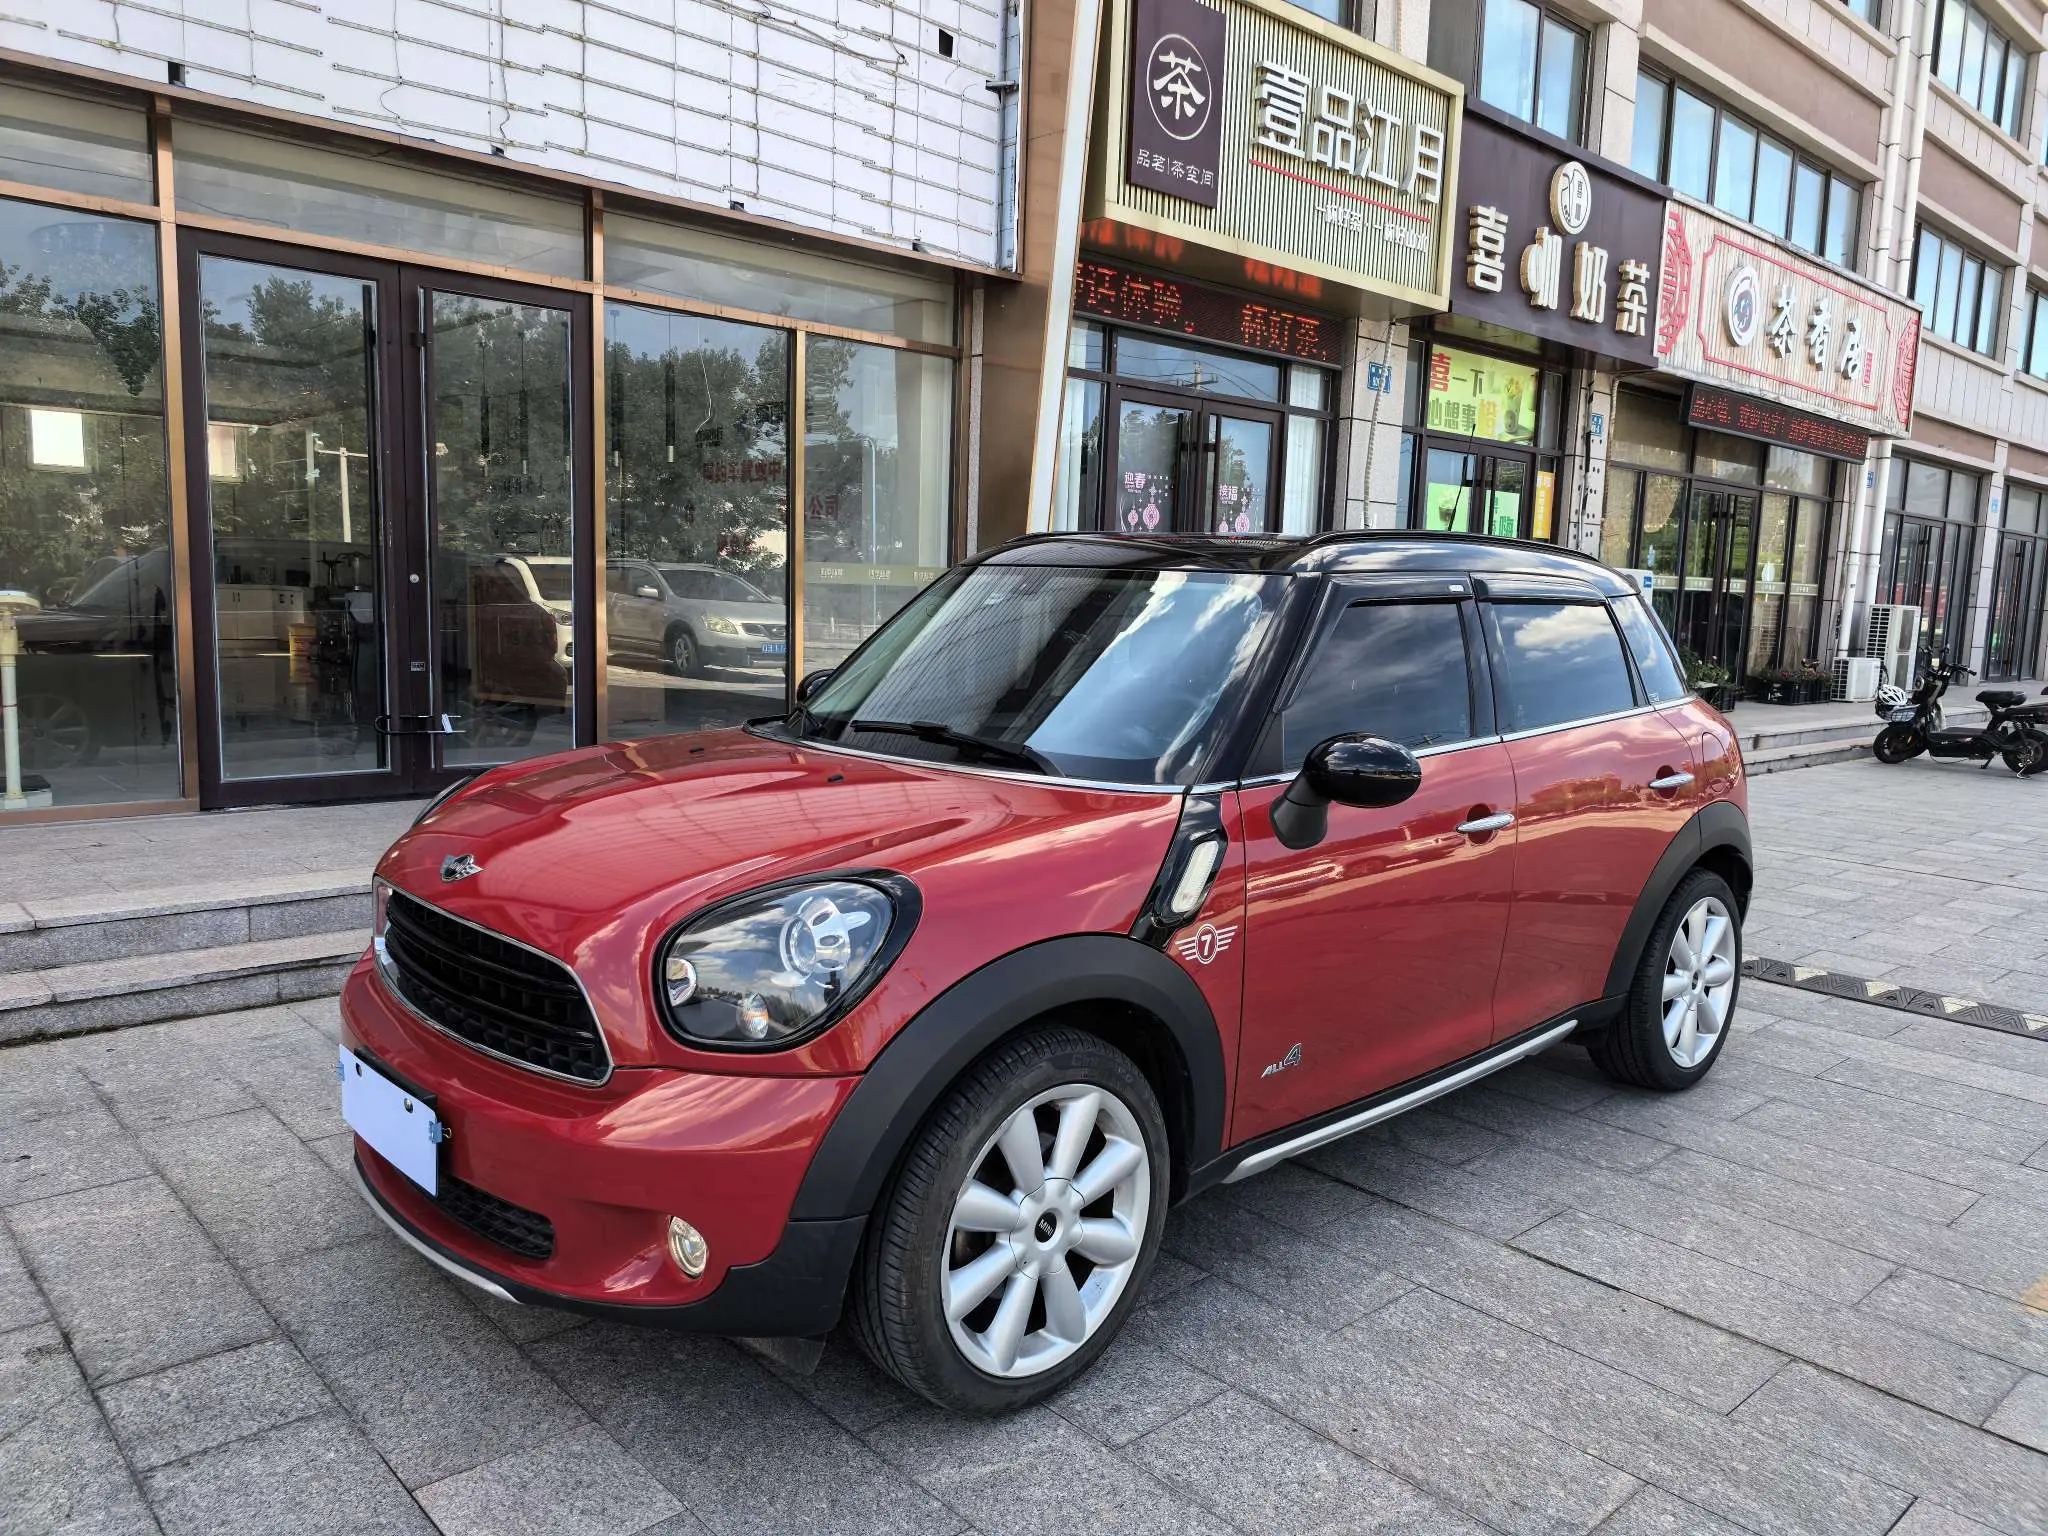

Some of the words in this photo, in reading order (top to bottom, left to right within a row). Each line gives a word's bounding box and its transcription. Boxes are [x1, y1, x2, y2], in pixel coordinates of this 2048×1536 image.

[1153, 51, 1206, 120] 茶
[1252, 59, 1445, 204] 壹品江月
[1199, 934, 1212, 956] 7
